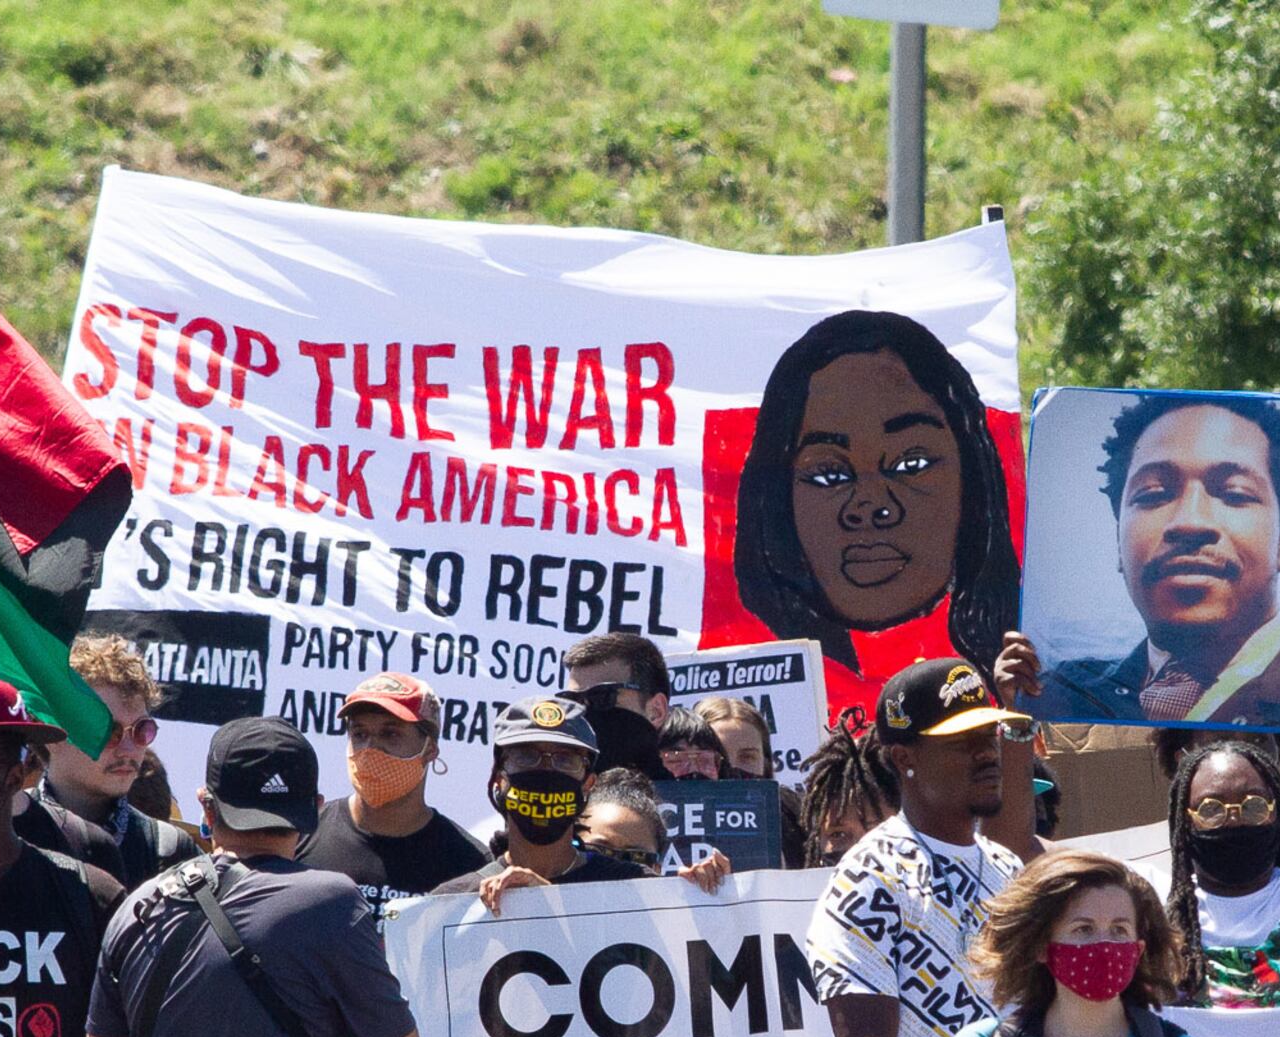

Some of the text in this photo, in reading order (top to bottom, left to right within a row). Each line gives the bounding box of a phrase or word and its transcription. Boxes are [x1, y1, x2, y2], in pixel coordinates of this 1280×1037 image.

[73, 303, 676, 450] STOP THE WAR
[169, 420, 376, 520] BLACK
[395, 452, 688, 548] AMERICA
[187, 521, 371, 608] RIGHT
[390, 548, 464, 618] TO
[486, 553, 678, 638] REBEL
[143, 640, 264, 691] ATLANTA
[280, 622, 398, 672] PARTY
[412, 630, 478, 679] FOR
[727, 656, 792, 687] Terror!
[281, 689, 347, 737] AND
[505, 799, 577, 818] POLICE
[507, 787, 575, 804] DEFUND
[715, 811, 758, 828] FOR
